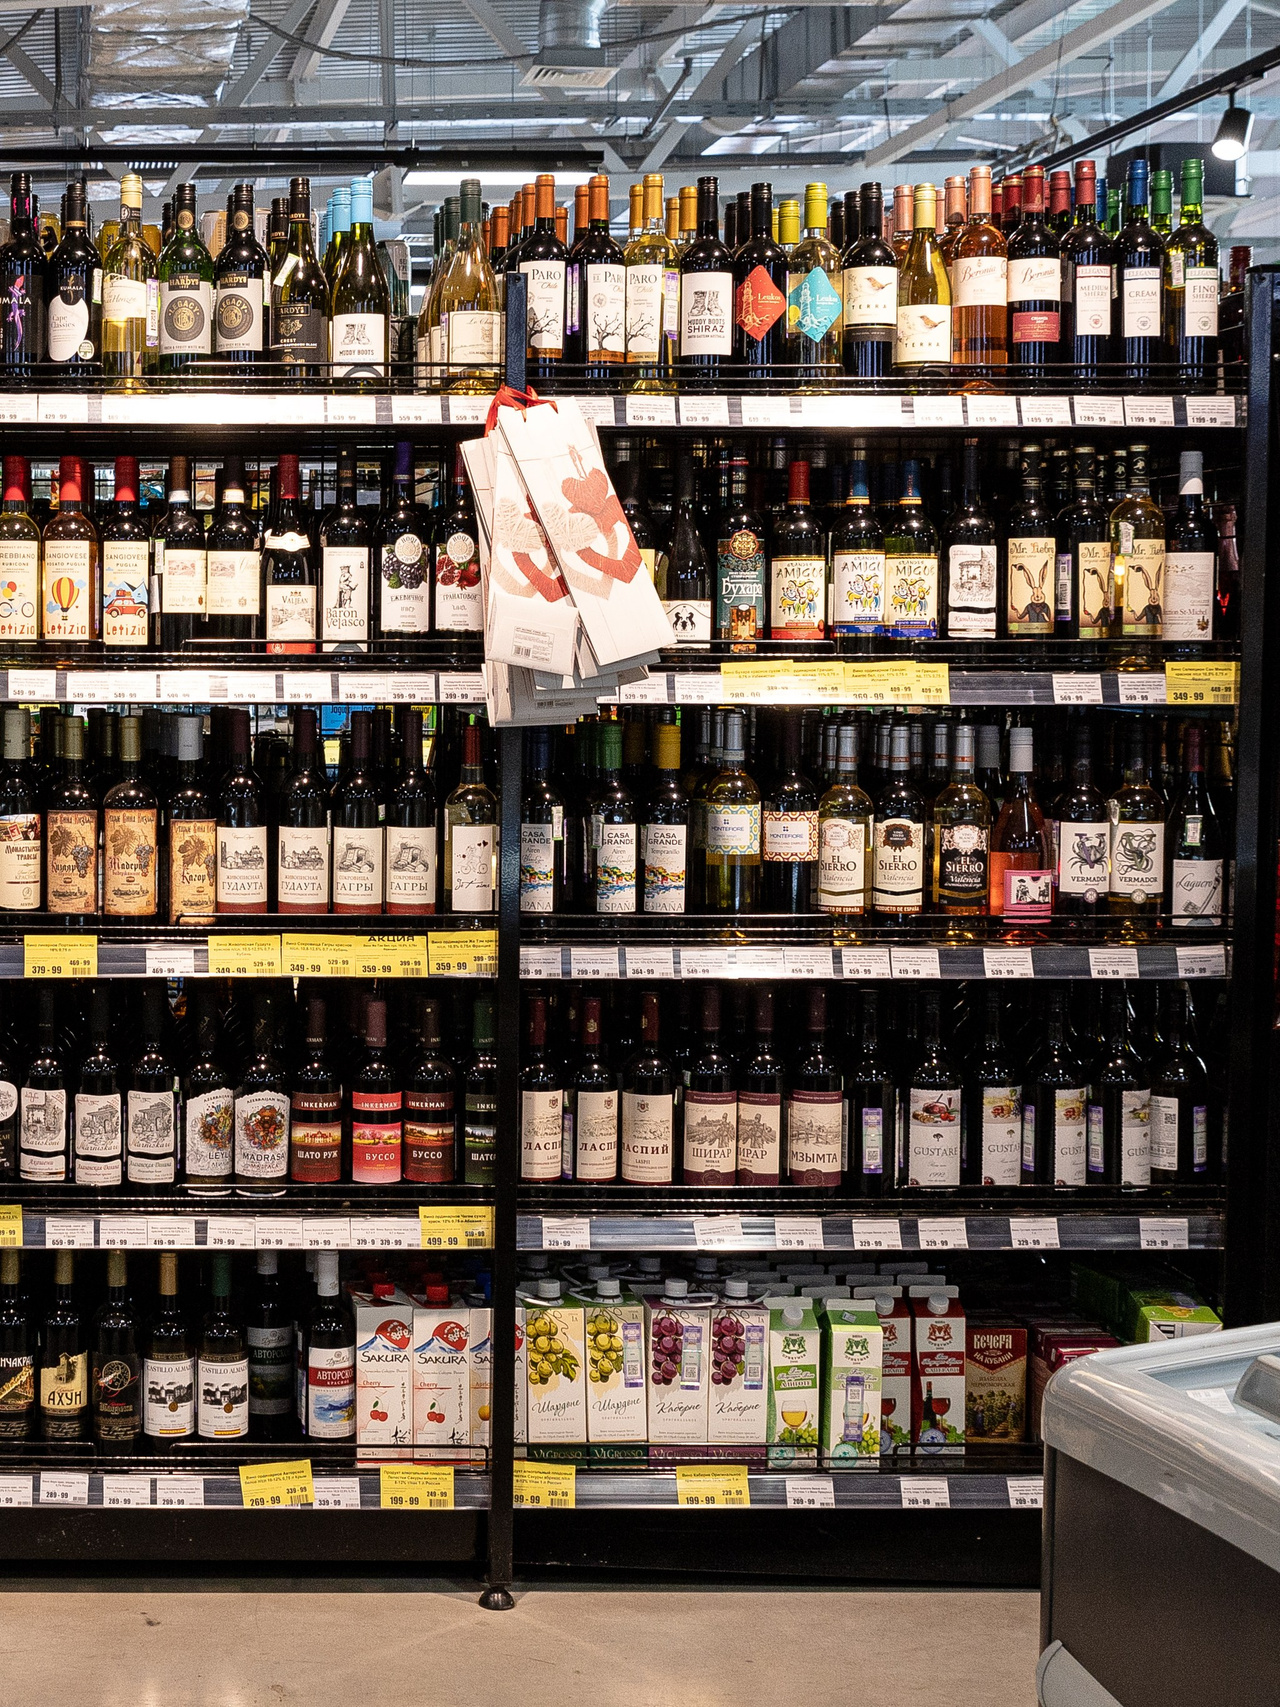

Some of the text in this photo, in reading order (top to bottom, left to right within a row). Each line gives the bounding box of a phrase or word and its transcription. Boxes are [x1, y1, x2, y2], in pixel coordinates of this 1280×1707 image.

[531, 268, 561, 281] PARO
[630, 273, 657, 284] PARO
[1192, 285, 1216, 293] FINO
[687, 325, 724, 333] SHIRAZ
[777, 567, 823, 578] AMIGOS
[721, 577, 763, 603] Бухара
[282, 596, 309, 605] VALJEAN
[442, 593, 478, 601] ГРАНАТОВОЕ
[326, 608, 358, 618] Baron
[326, 617, 365, 629] Velasco
[648, 838, 683, 846] GRANDE
[831, 855, 842, 863] EL
[820, 861, 857, 872] SIERRO
[878, 860, 917, 871] SIERRO
[222, 881, 264, 892] ГУДАУТА
[281, 881, 322, 892] ГУДАУТА
[336, 882, 374, 892] ГАГРЫ
[390, 882, 428, 892] ГАГРЫ
[644, 901, 684, 912] ESPAÑA
[242, 1153, 285, 1161] MADRASA
[297, 1150, 338, 1159] ШАТО РУЖ
[365, 1152, 395, 1161] БУССО
[412, 1151, 442, 1160] БУССО
[692, 1147, 732, 1158] ШИРАР
[791, 1150, 837, 1163] МЗЫМТА
[973, 1334, 1012, 1349] ВЕЧЕРА
[361, 1351, 410, 1364] SAKURA
[417, 1352, 467, 1365] SAKURA
[419, 1381, 438, 1389] Cherry
[46, 1393, 83, 1406] АХУН
[592, 1397, 642, 1414] Шардоне
[655, 1402, 702, 1415] Каберне
[715, 1401, 761, 1415] Каберне
